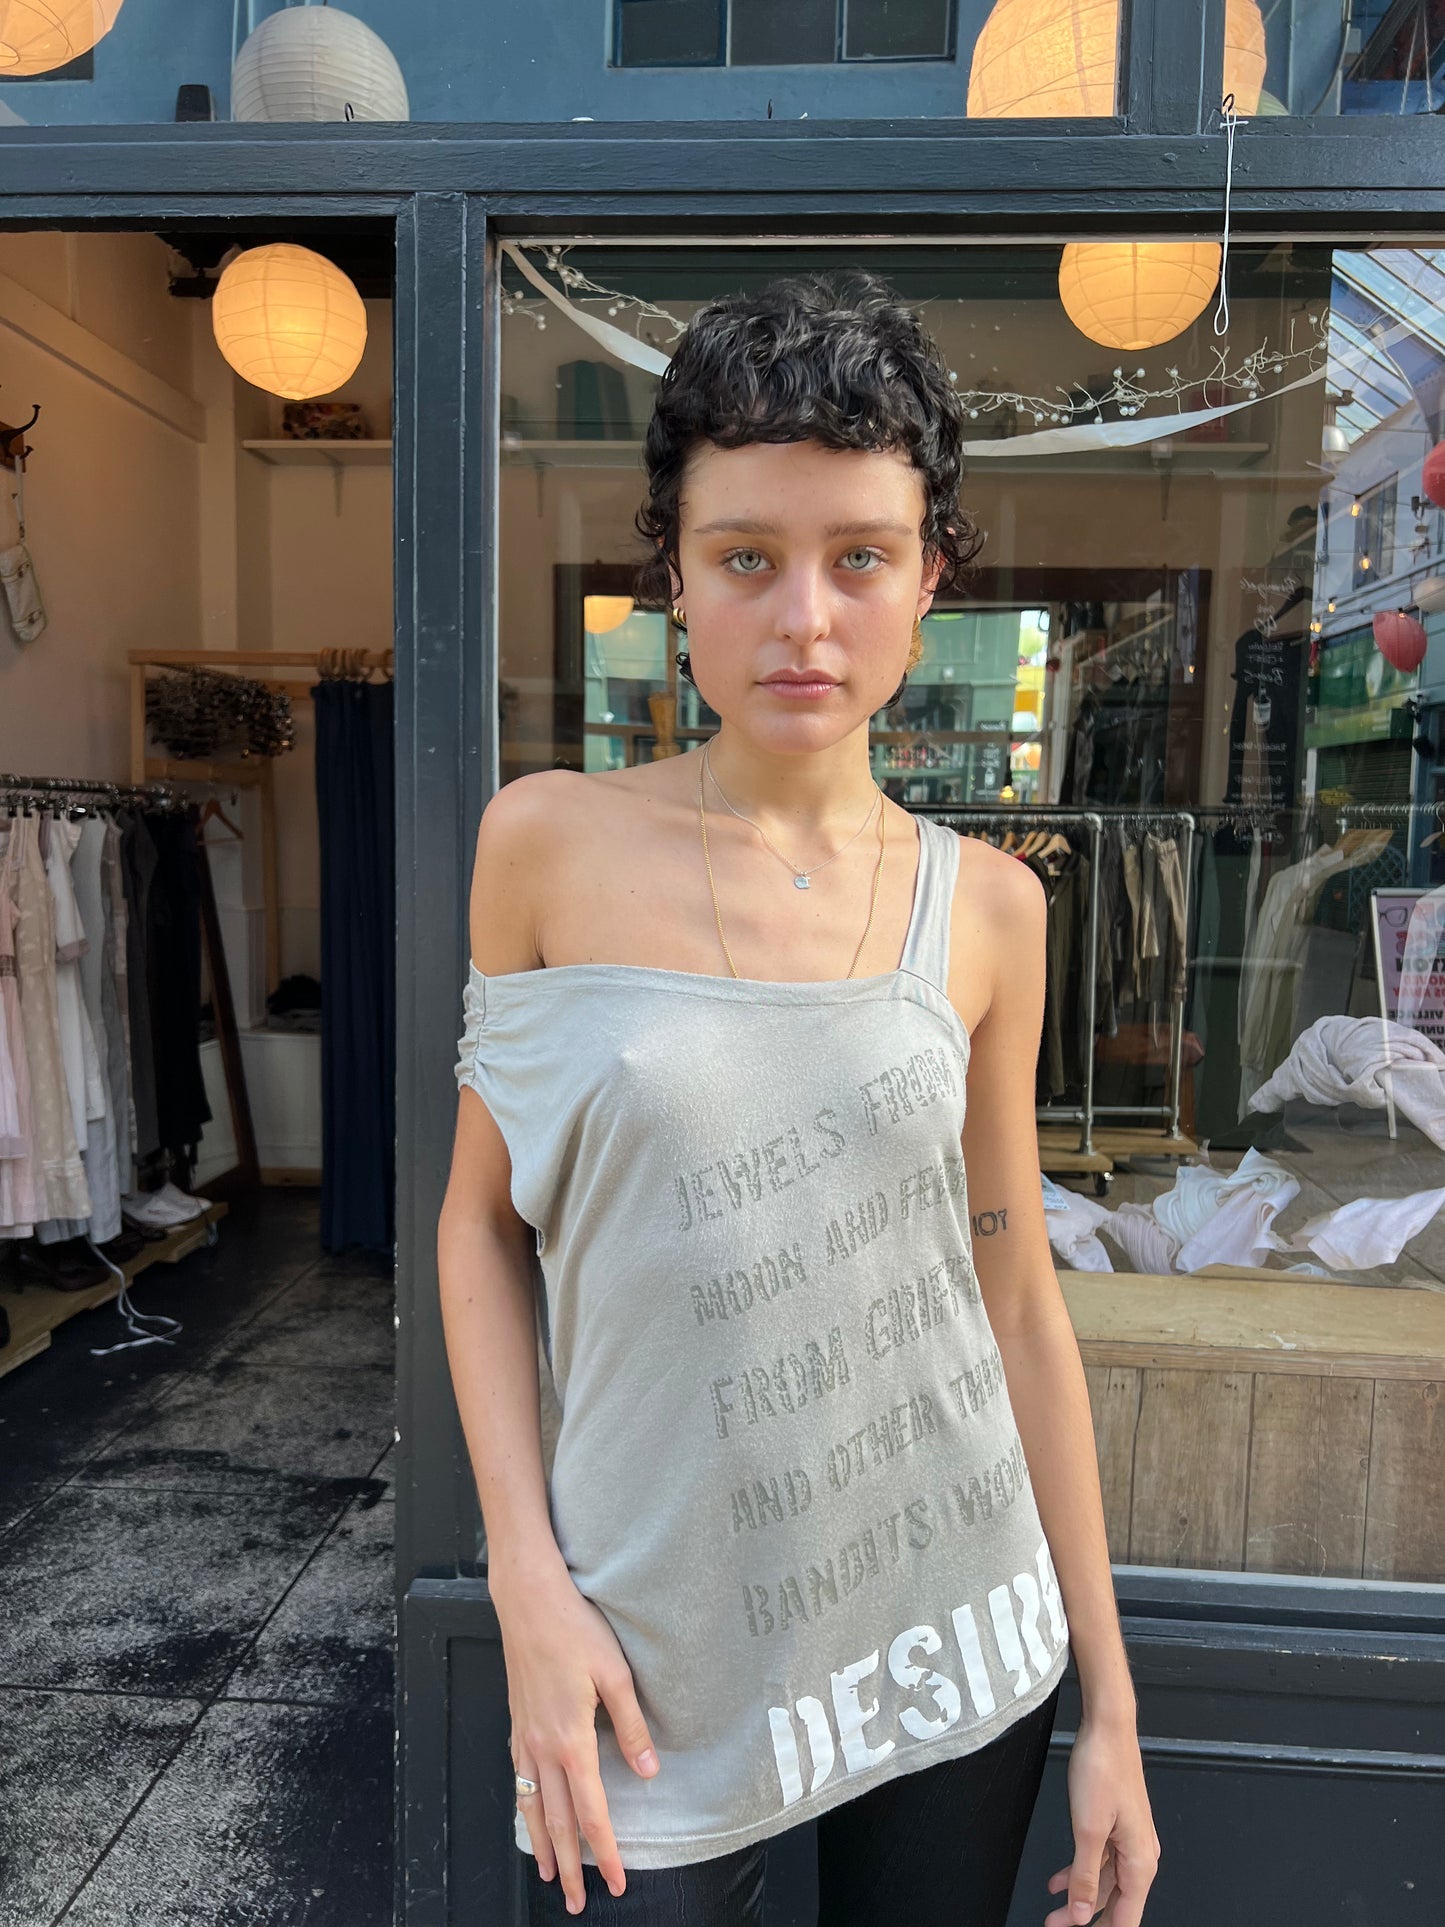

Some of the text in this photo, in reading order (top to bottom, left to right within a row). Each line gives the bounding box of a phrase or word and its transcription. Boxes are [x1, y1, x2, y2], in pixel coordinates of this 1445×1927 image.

[672, 1048, 957, 1231] JEWELS FROM
[690, 1243, 807, 1326] MOON
[827, 1192, 888, 1265] AND
[708, 1326, 850, 1440] FROM
[731, 1469, 812, 1533] AND
[828, 1393, 938, 1492] OTHER
[742, 1499, 934, 1637] BANDITS
